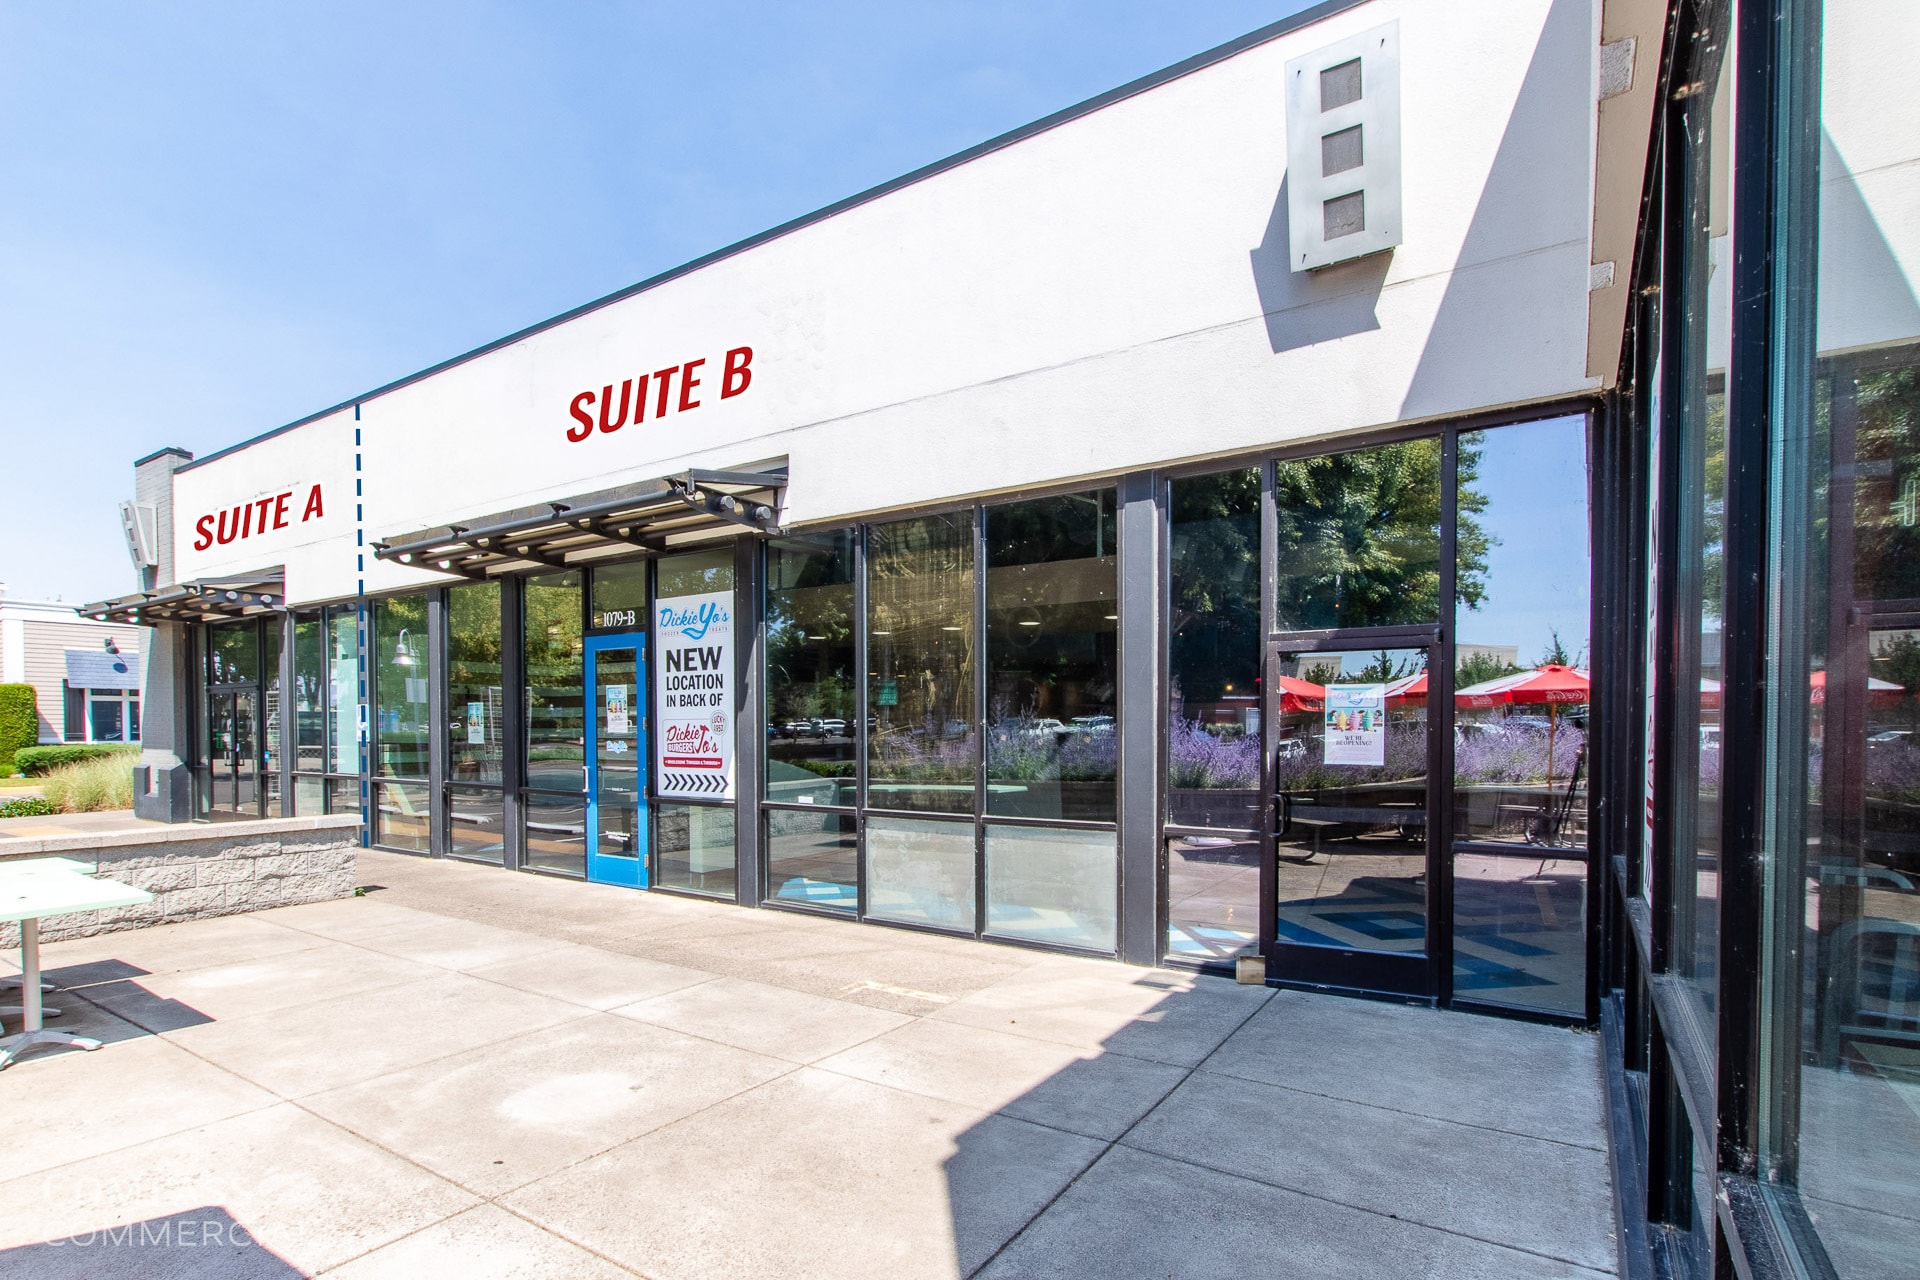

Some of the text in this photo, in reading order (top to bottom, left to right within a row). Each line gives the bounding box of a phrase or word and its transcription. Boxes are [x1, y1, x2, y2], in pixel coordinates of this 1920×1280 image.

[603, 610, 636, 627] 1079-B
[660, 602, 729, 640] Dickie Yo's
[666, 645, 723, 672] NEW
[666, 674, 723, 690] LOCATION
[666, 693, 723, 707] IN BACK OF
[666, 723, 719, 754] Dickie Jo's
[668, 742, 694, 753] BURGERS
